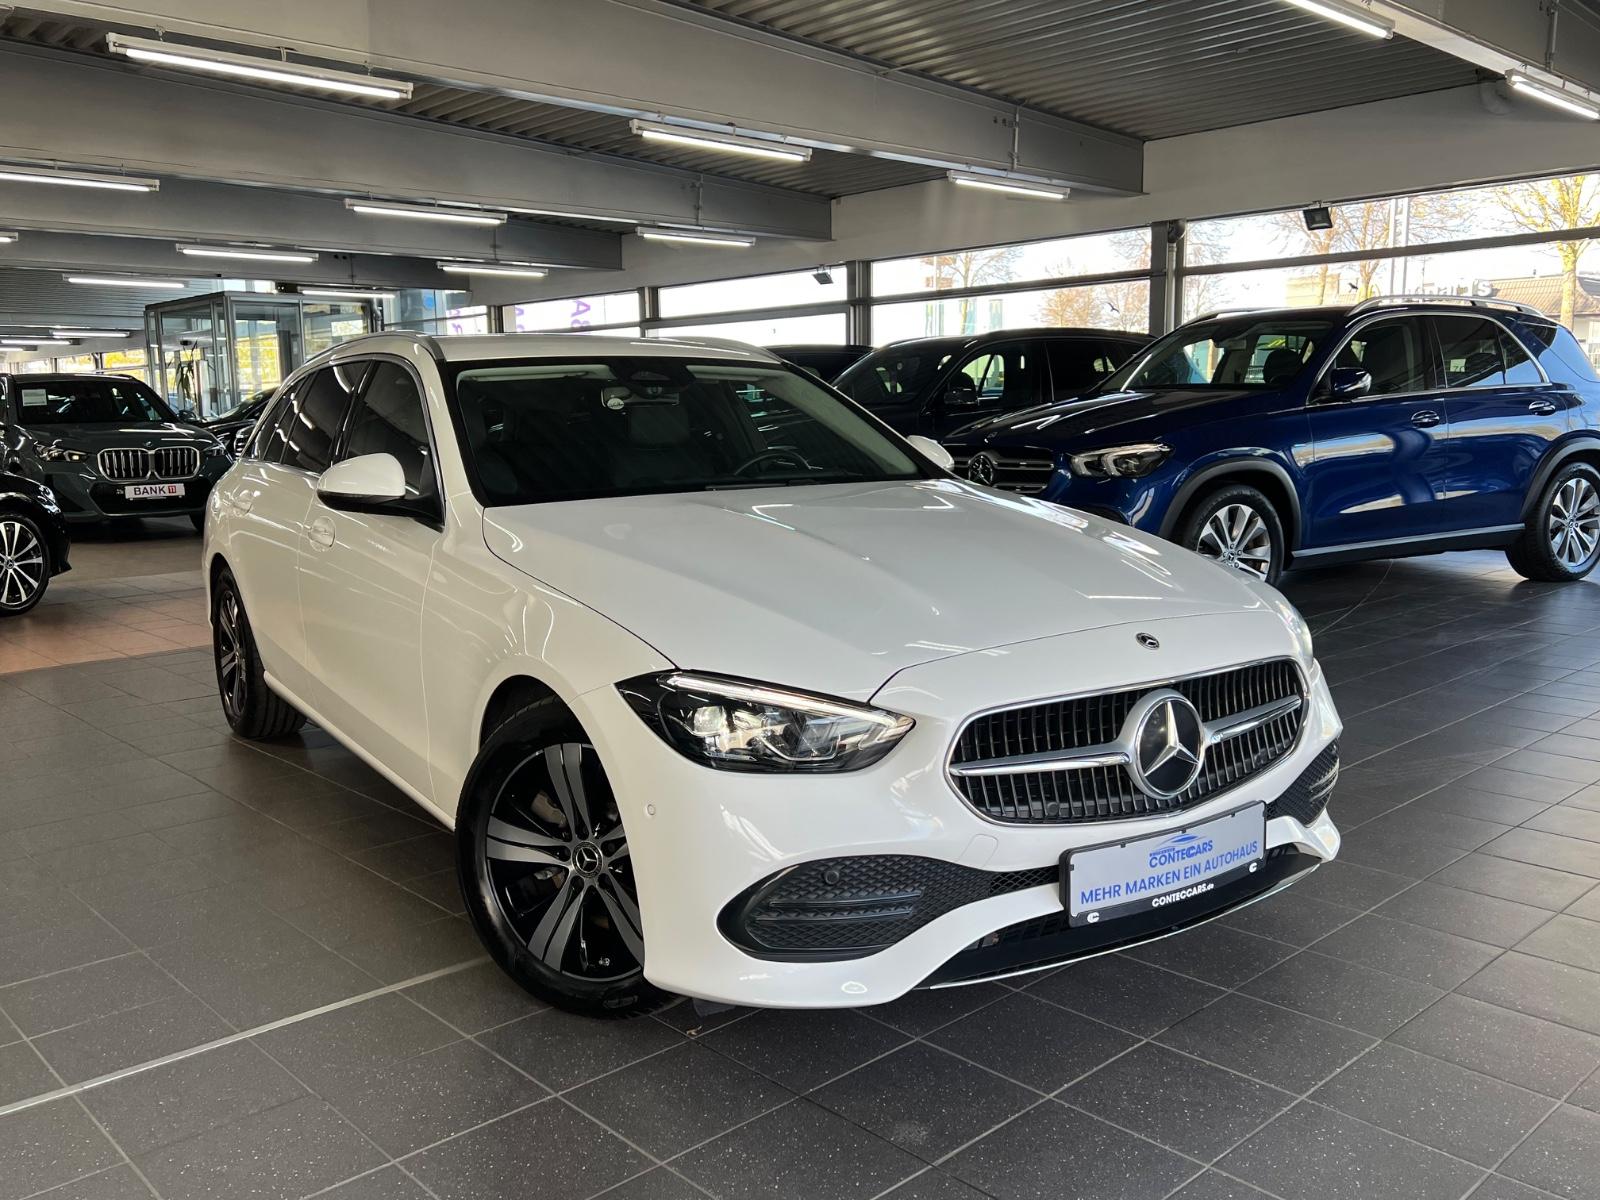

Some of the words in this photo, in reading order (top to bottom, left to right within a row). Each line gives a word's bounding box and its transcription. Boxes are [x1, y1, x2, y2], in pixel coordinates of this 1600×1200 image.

[134, 486, 166, 495] BANK
[1081, 884, 1121, 904] MEHR
[1125, 869, 1180, 895] MARKEN
[1184, 863, 1200, 879] EIN
[1204, 841, 1257, 872] AUTOHAUS
